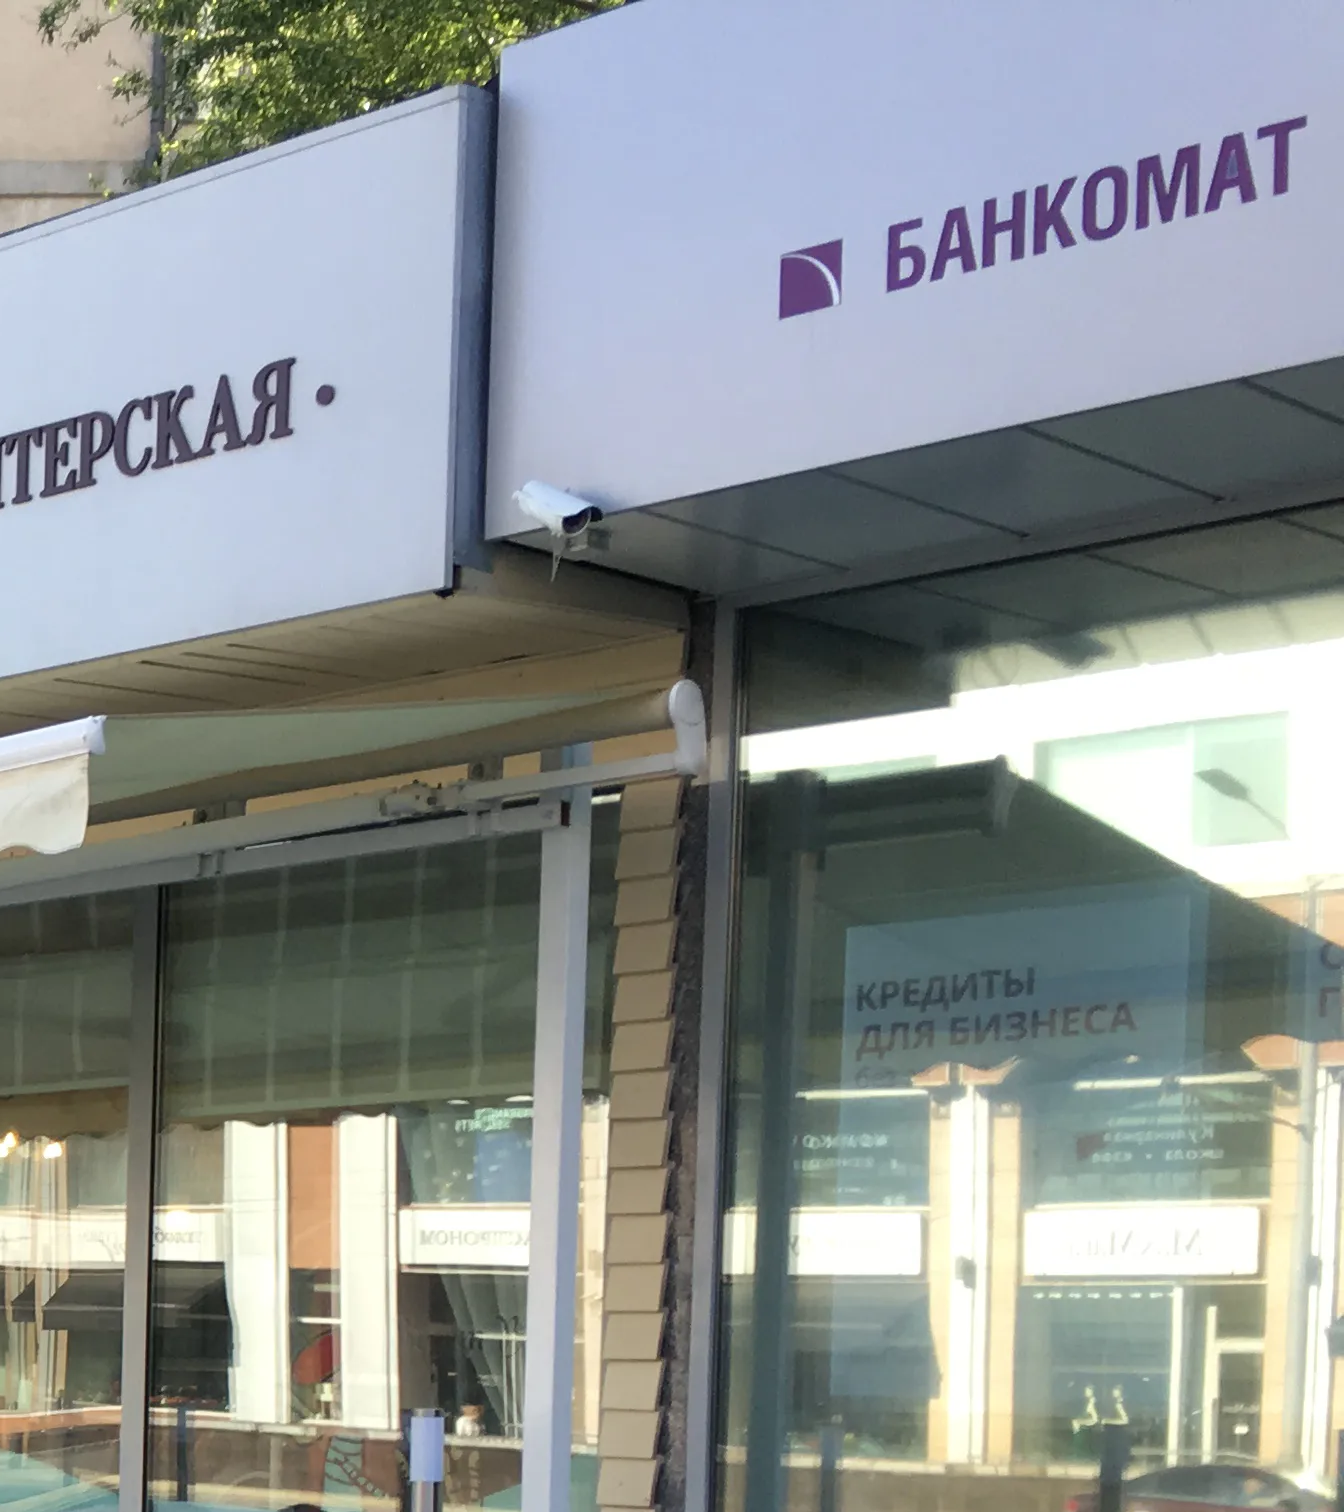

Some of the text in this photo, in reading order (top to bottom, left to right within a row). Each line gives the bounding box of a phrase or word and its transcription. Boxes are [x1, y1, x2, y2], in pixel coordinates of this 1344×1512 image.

[885, 114, 1308, 294] БАНКОМАТ
[855, 967, 1036, 1013] КРЕДИТЫ
[855, 1002, 1137, 1062] ДЛЯ БИЗНЕСА
